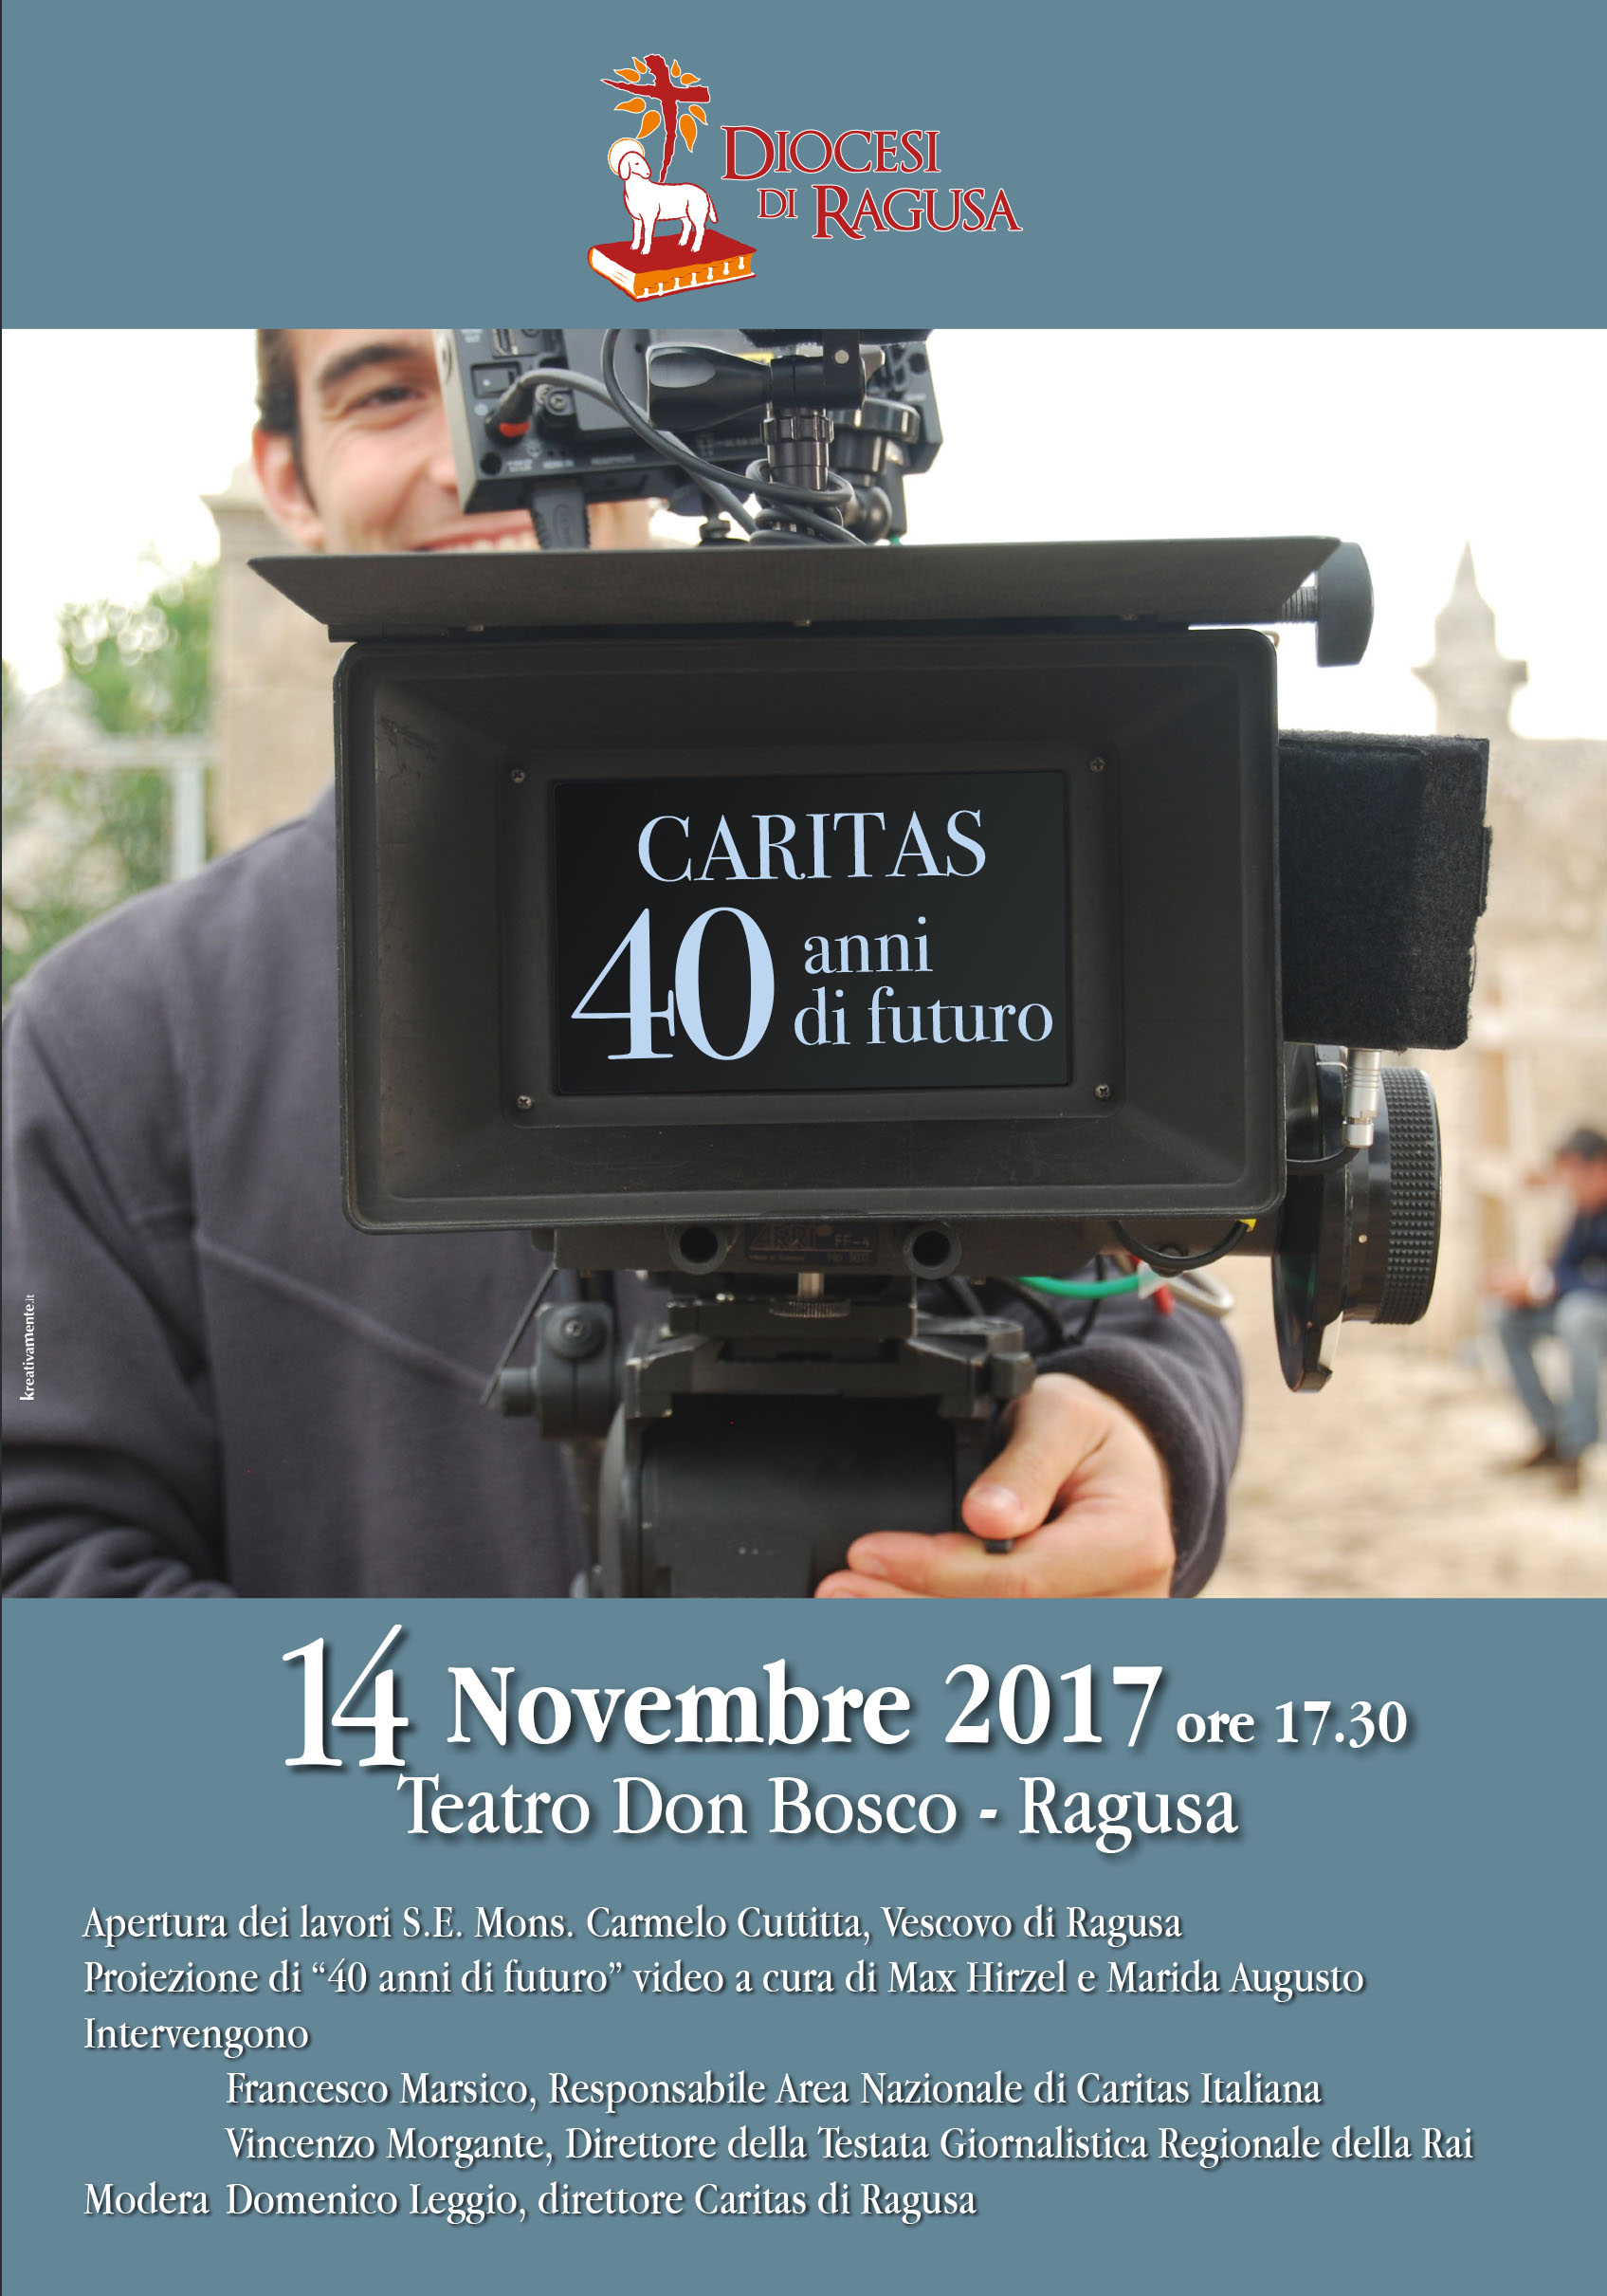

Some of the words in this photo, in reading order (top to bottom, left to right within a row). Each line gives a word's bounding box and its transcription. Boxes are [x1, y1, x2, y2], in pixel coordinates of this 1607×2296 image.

[721, 125, 940, 181] DIOCESI
[758, 188, 797, 219] DI
[812, 184, 1023, 240] RAGUSA
[638, 809, 986, 882] CARITAS
[571, 907, 775, 1061] 40
[804, 916, 934, 975] anni
[794, 986, 851, 1045] di
[867, 985, 1053, 1044] futuro
[283, 1625, 409, 1767] 14
[447, 1659, 910, 1746] Novembre
[944, 1664, 1163, 1748] 2017
[1177, 1710, 1255, 1743] ore
[1275, 1700, 1407, 1749] 17.30
[397, 1773, 590, 1834] Teatro
[612, 1777, 748, 1834] Don
[768, 1777, 957, 1834] Bosco
[979, 1809, 997, 1819] -
[1018, 1777, 1239, 1854] Ragusa
[82, 1907, 228, 1947] Apertura
[239, 1904, 288, 1937] dei
[301, 1904, 391, 1937] lavori
[404, 1907, 463, 1937] S.E.
[475, 1907, 574, 1937] Mons.
[588, 1904, 725, 1937] Carmelo
[739, 1907, 869, 1945] Cuttitta,
[881, 1907, 1011, 1937] Vescovo
[1024, 1904, 1054, 1937] di
[1067, 1907, 1182, 1947] Ragusa
[84, 1962, 257, 1992] Proiezione
[269, 1959, 301, 1992] di
[313, 1958, 366, 1992] “40
[379, 1962, 450, 1992] anni
[462, 1959, 493, 1992] di
[504, 1959, 621, 1992] futuro”
[632, 1959, 722, 1992] video
[736, 1971, 752, 1992] a
[763, 1970, 834, 1992] cura
[846, 1959, 876, 1992] di
[887, 1962, 956, 1993] Max
[967, 1959, 1066, 1992] Hirzel
[1078, 1971, 1094, 1992] e
[1107, 1959, 1220, 1992] Marida
[1229, 1963, 1363, 2002] Augusto
[84, 2018, 308, 2058] Intervengono
[227, 2073, 387, 2103] Francesco
[399, 2073, 536, 2111] Marsico,
[549, 2070, 764, 2113] Responsabile
[775, 2074, 849, 2103] Area
[861, 2071, 1021, 2103] Nazionale
[1034, 2070, 1066, 2103] di
[1077, 2073, 1189, 2103] Caritas
[1201, 2070, 1321, 2103] Italiana
[225, 2128, 374, 2158] Vincenzo
[387, 2128, 552, 2168] Morgante,
[566, 2128, 715, 2158] Direttore
[728, 2125, 807, 2158] della
[818, 2126, 929, 2158] Testata
[940, 2125, 1147, 2158] Giornalistica
[1159, 2125, 1320, 2168] Regionale
[1332, 2125, 1411, 2158] della
[1422, 2128, 1472, 2158] Rai
[83, 2181, 210, 2213] Modera
[227, 2184, 396, 2213] Domenico
[410, 2184, 525, 2224] Leggio,
[539, 2181, 682, 2213] direttore
[696, 2184, 806, 2213] Caritas
[818, 2181, 849, 2213] di
[861, 2184, 976, 2224] Ragusa
